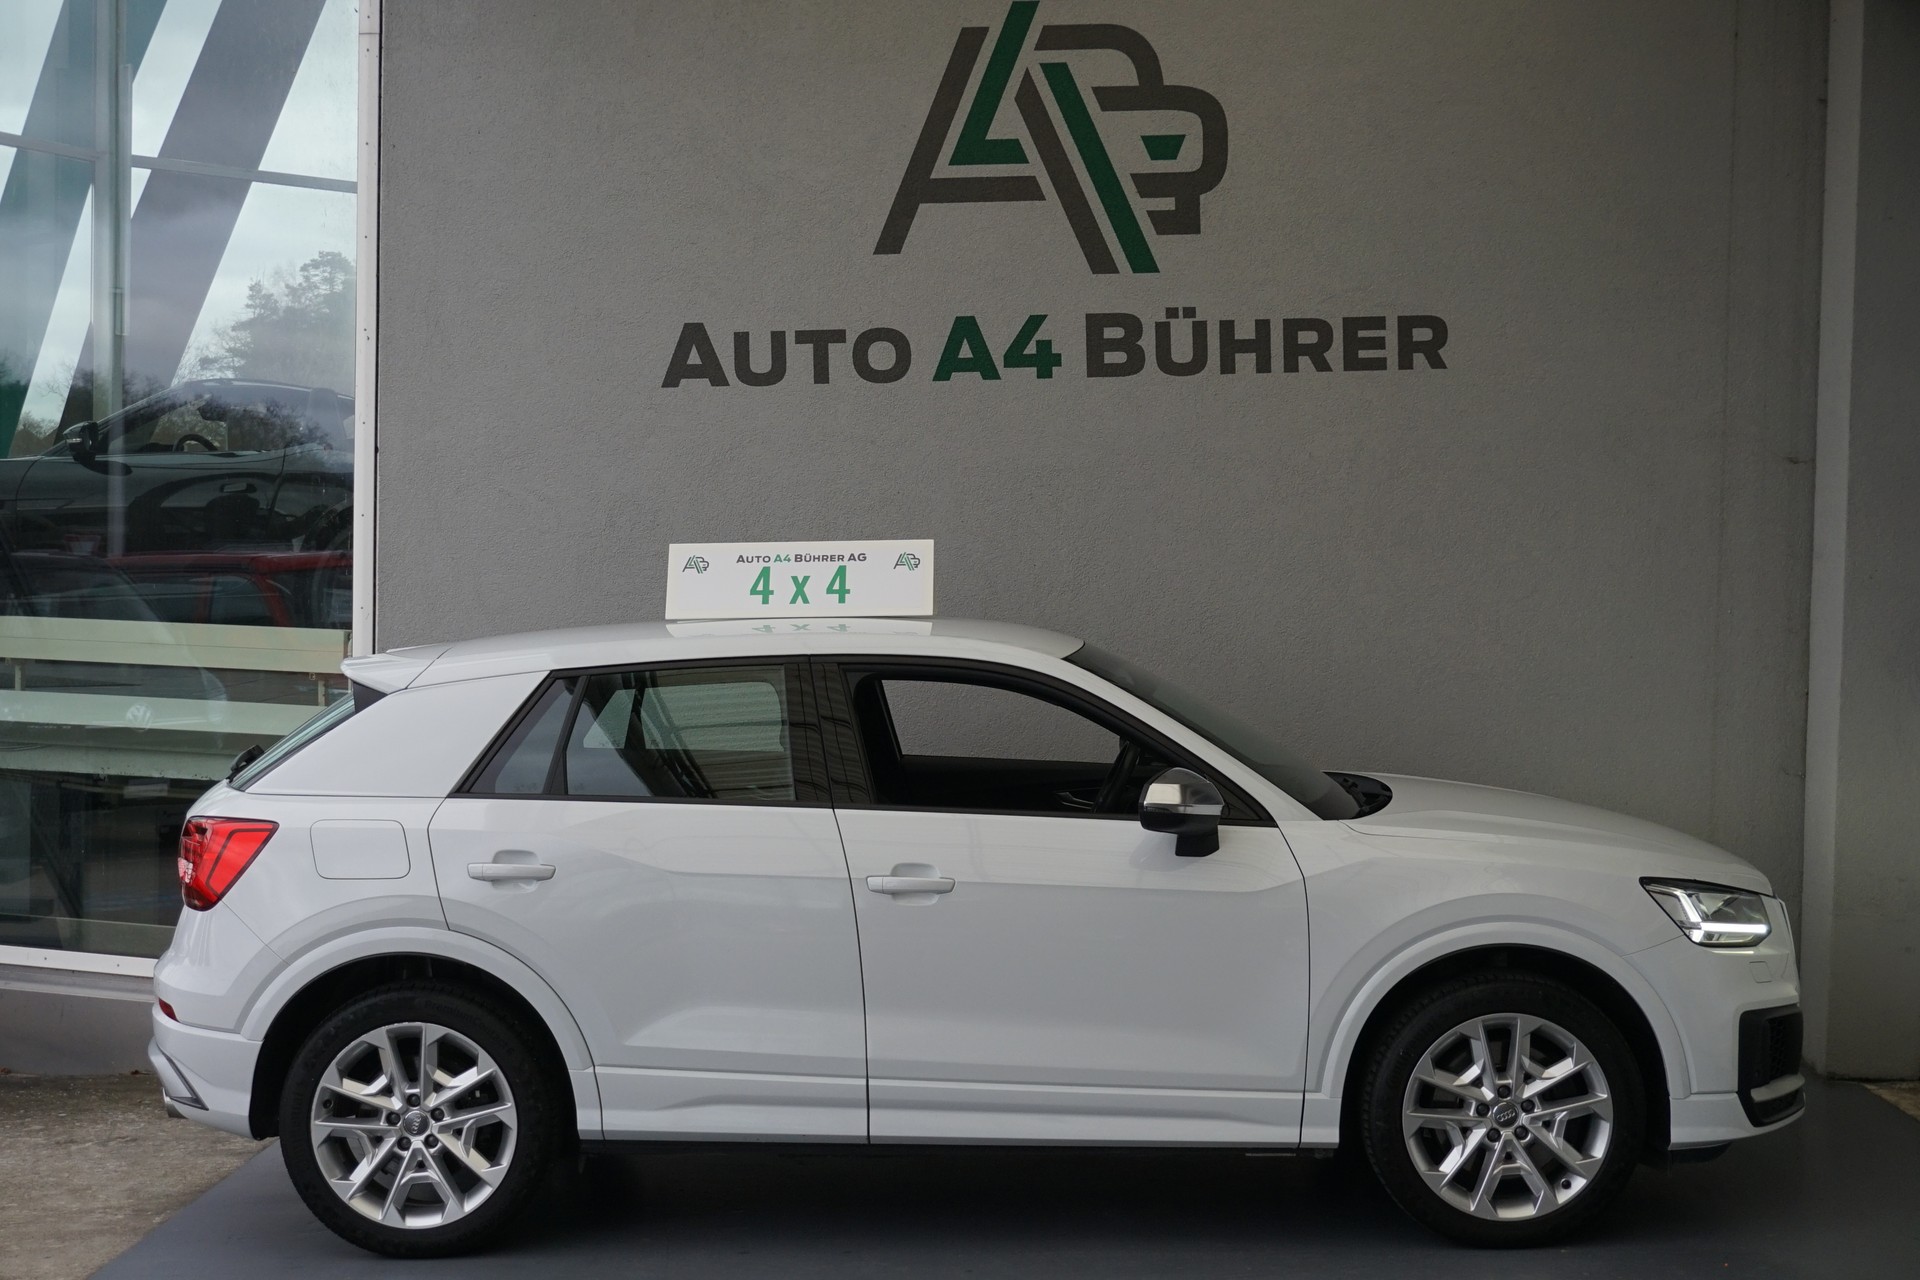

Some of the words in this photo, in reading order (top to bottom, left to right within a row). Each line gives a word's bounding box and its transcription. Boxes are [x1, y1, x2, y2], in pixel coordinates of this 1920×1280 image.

[661, 322, 912, 388] AUTO
[932, 315, 1062, 381] A4
[1085, 308, 1448, 378] BÜHRER
[736, 554, 771, 564] AUTO
[773, 554, 791, 563] A4
[794, 553, 845, 563] BÜHRER
[847, 552, 867, 562] AG
[750, 566, 774, 605] 4
[826, 565, 851, 604] 4
